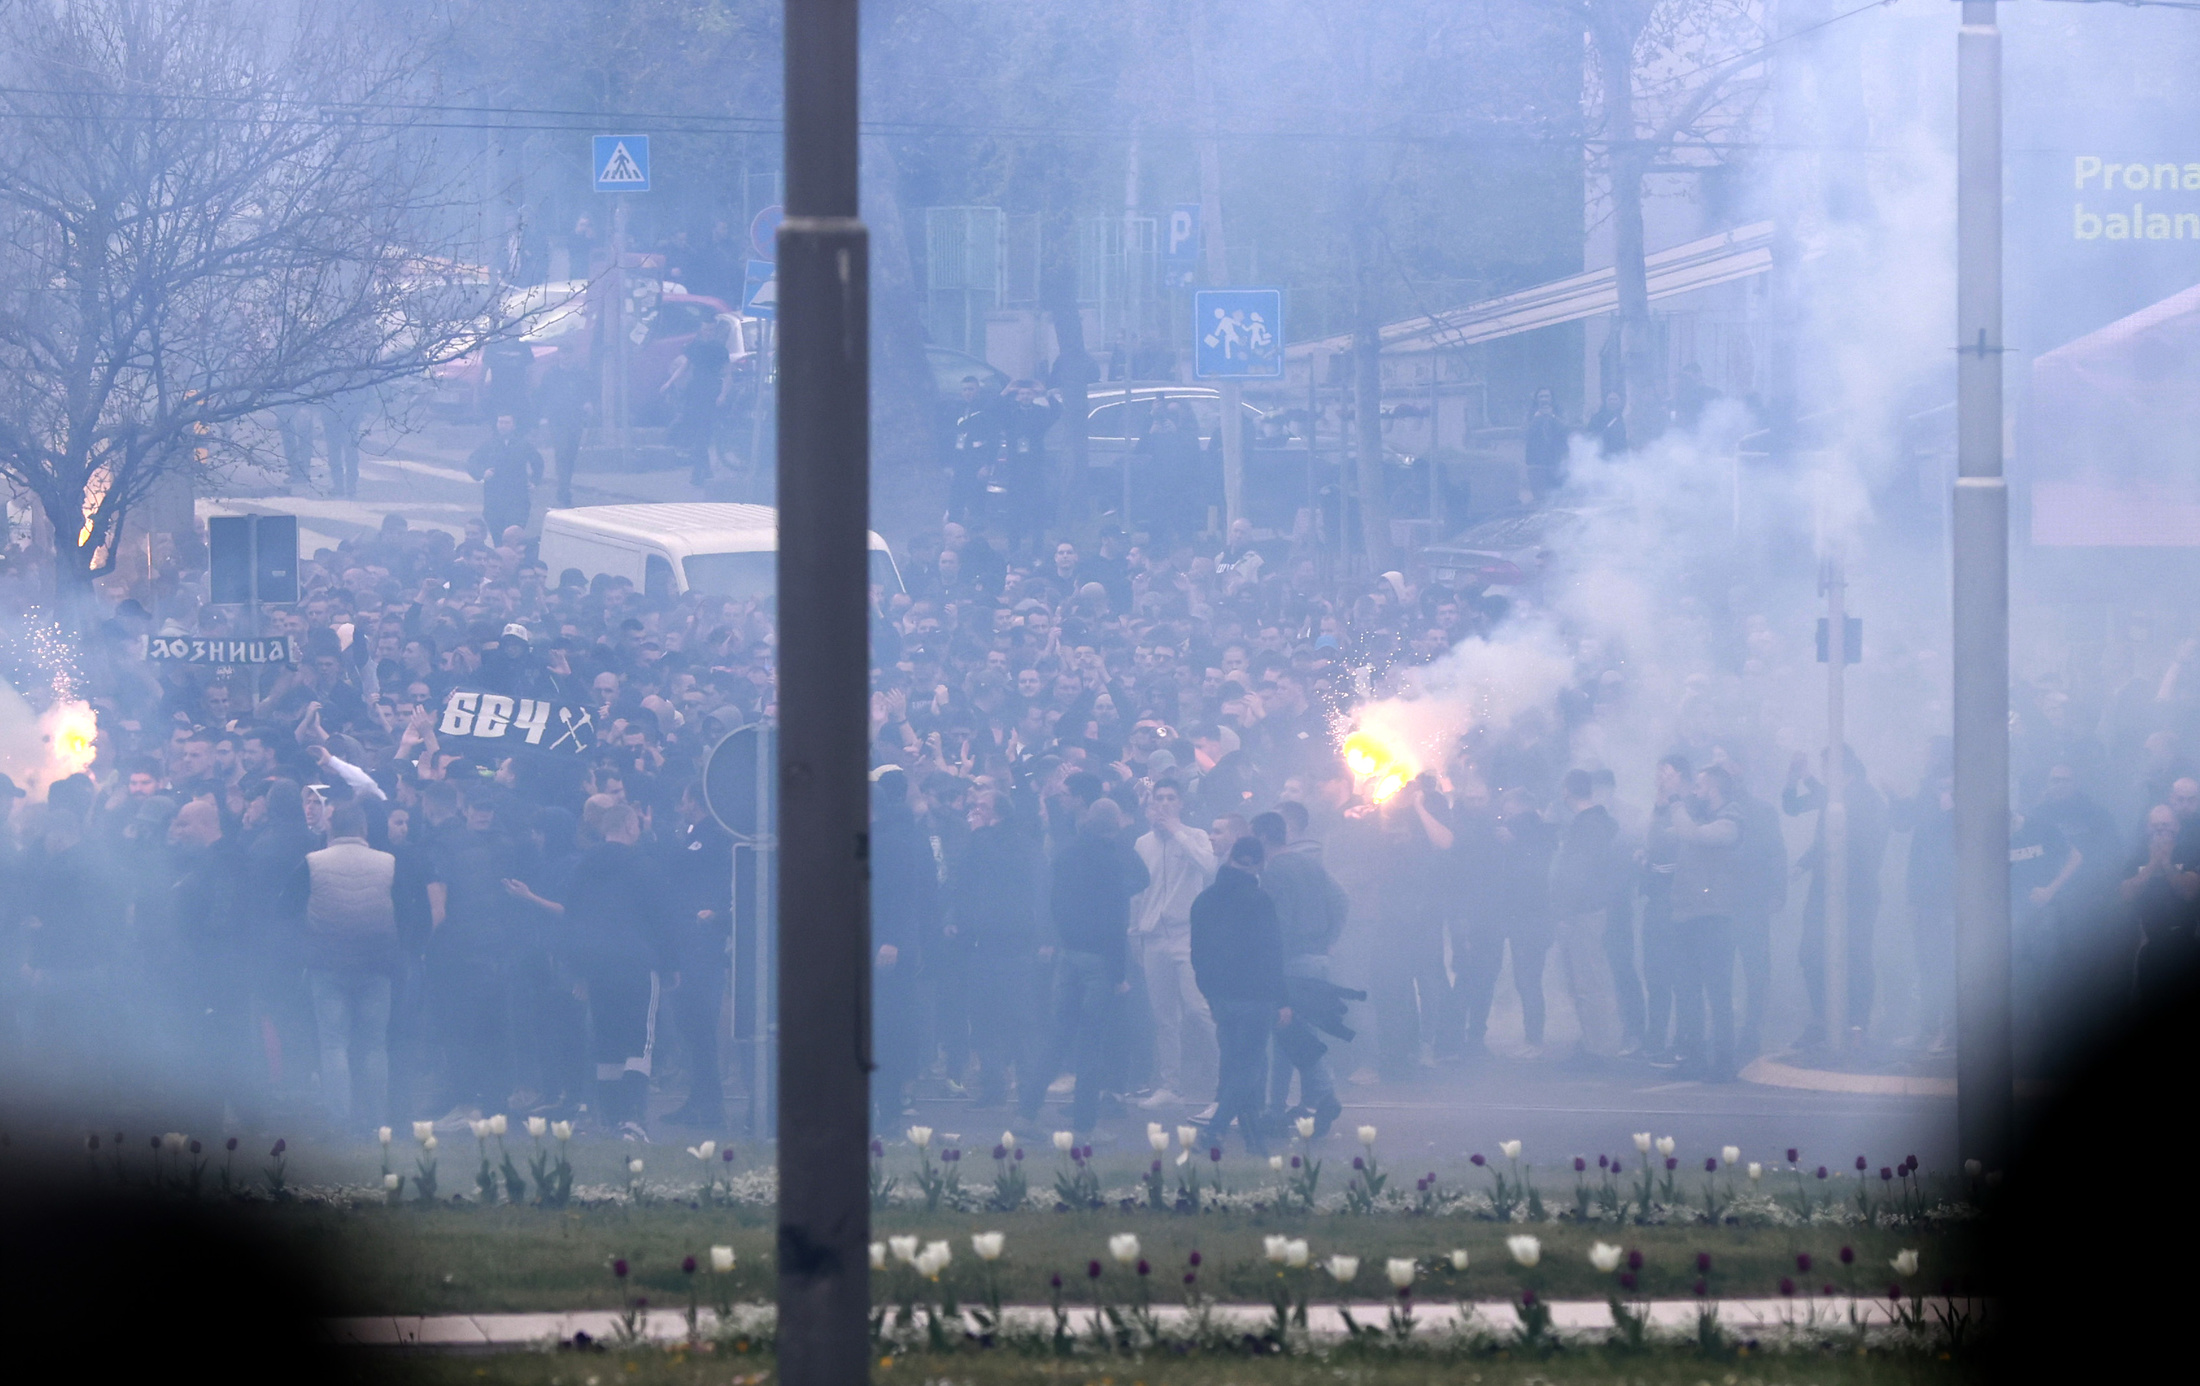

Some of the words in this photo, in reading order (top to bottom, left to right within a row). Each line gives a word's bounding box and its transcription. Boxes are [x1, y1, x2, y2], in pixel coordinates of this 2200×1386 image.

[2075, 155, 2200, 190] Prona
[1169, 211, 1192, 254] P
[2075, 202, 2200, 240] balan
